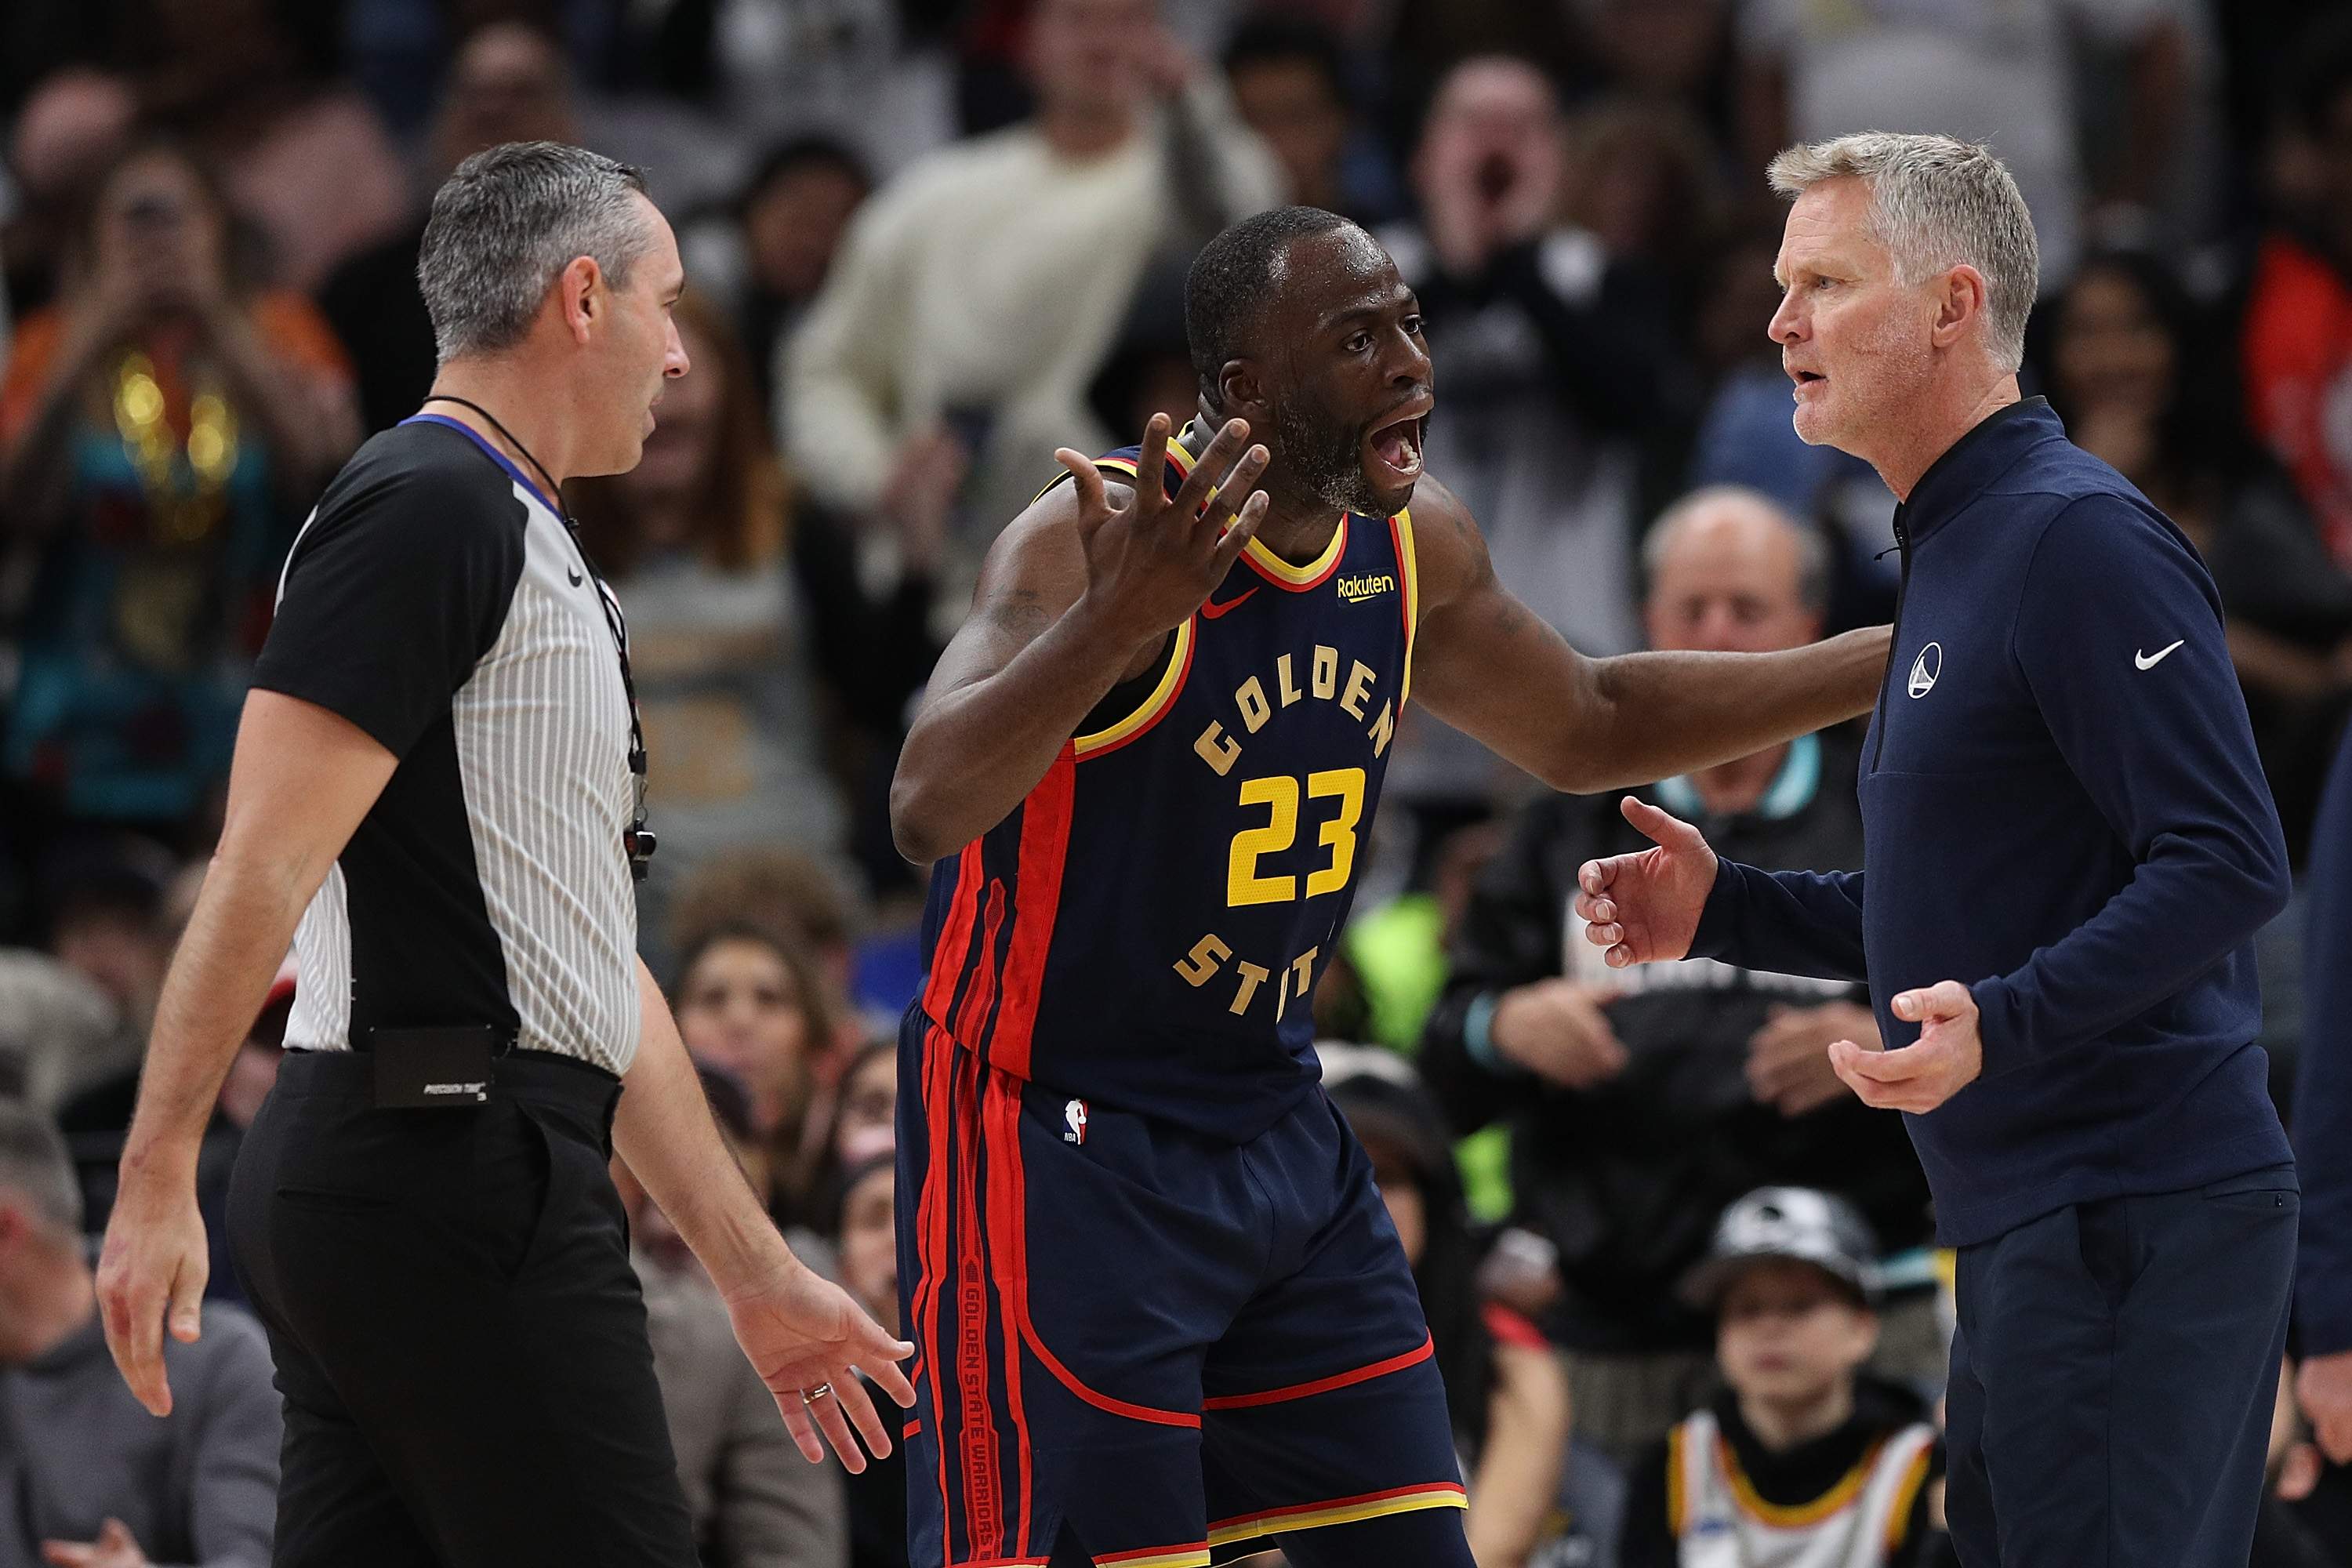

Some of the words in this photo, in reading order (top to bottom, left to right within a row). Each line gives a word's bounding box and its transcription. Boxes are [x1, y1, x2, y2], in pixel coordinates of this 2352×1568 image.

[1338, 574, 1395, 599] Rakuten
[1194, 644, 1394, 776] GOLDEN
[1227, 767, 1366, 907] 23
[1173, 920, 1335, 1025] STT
[1064, 1132, 1076, 1142] NBA
[964, 1288, 980, 1369] GOLDEN
[964, 1374, 985, 1439] STATE
[971, 1444, 994, 1546] WARRIORS
